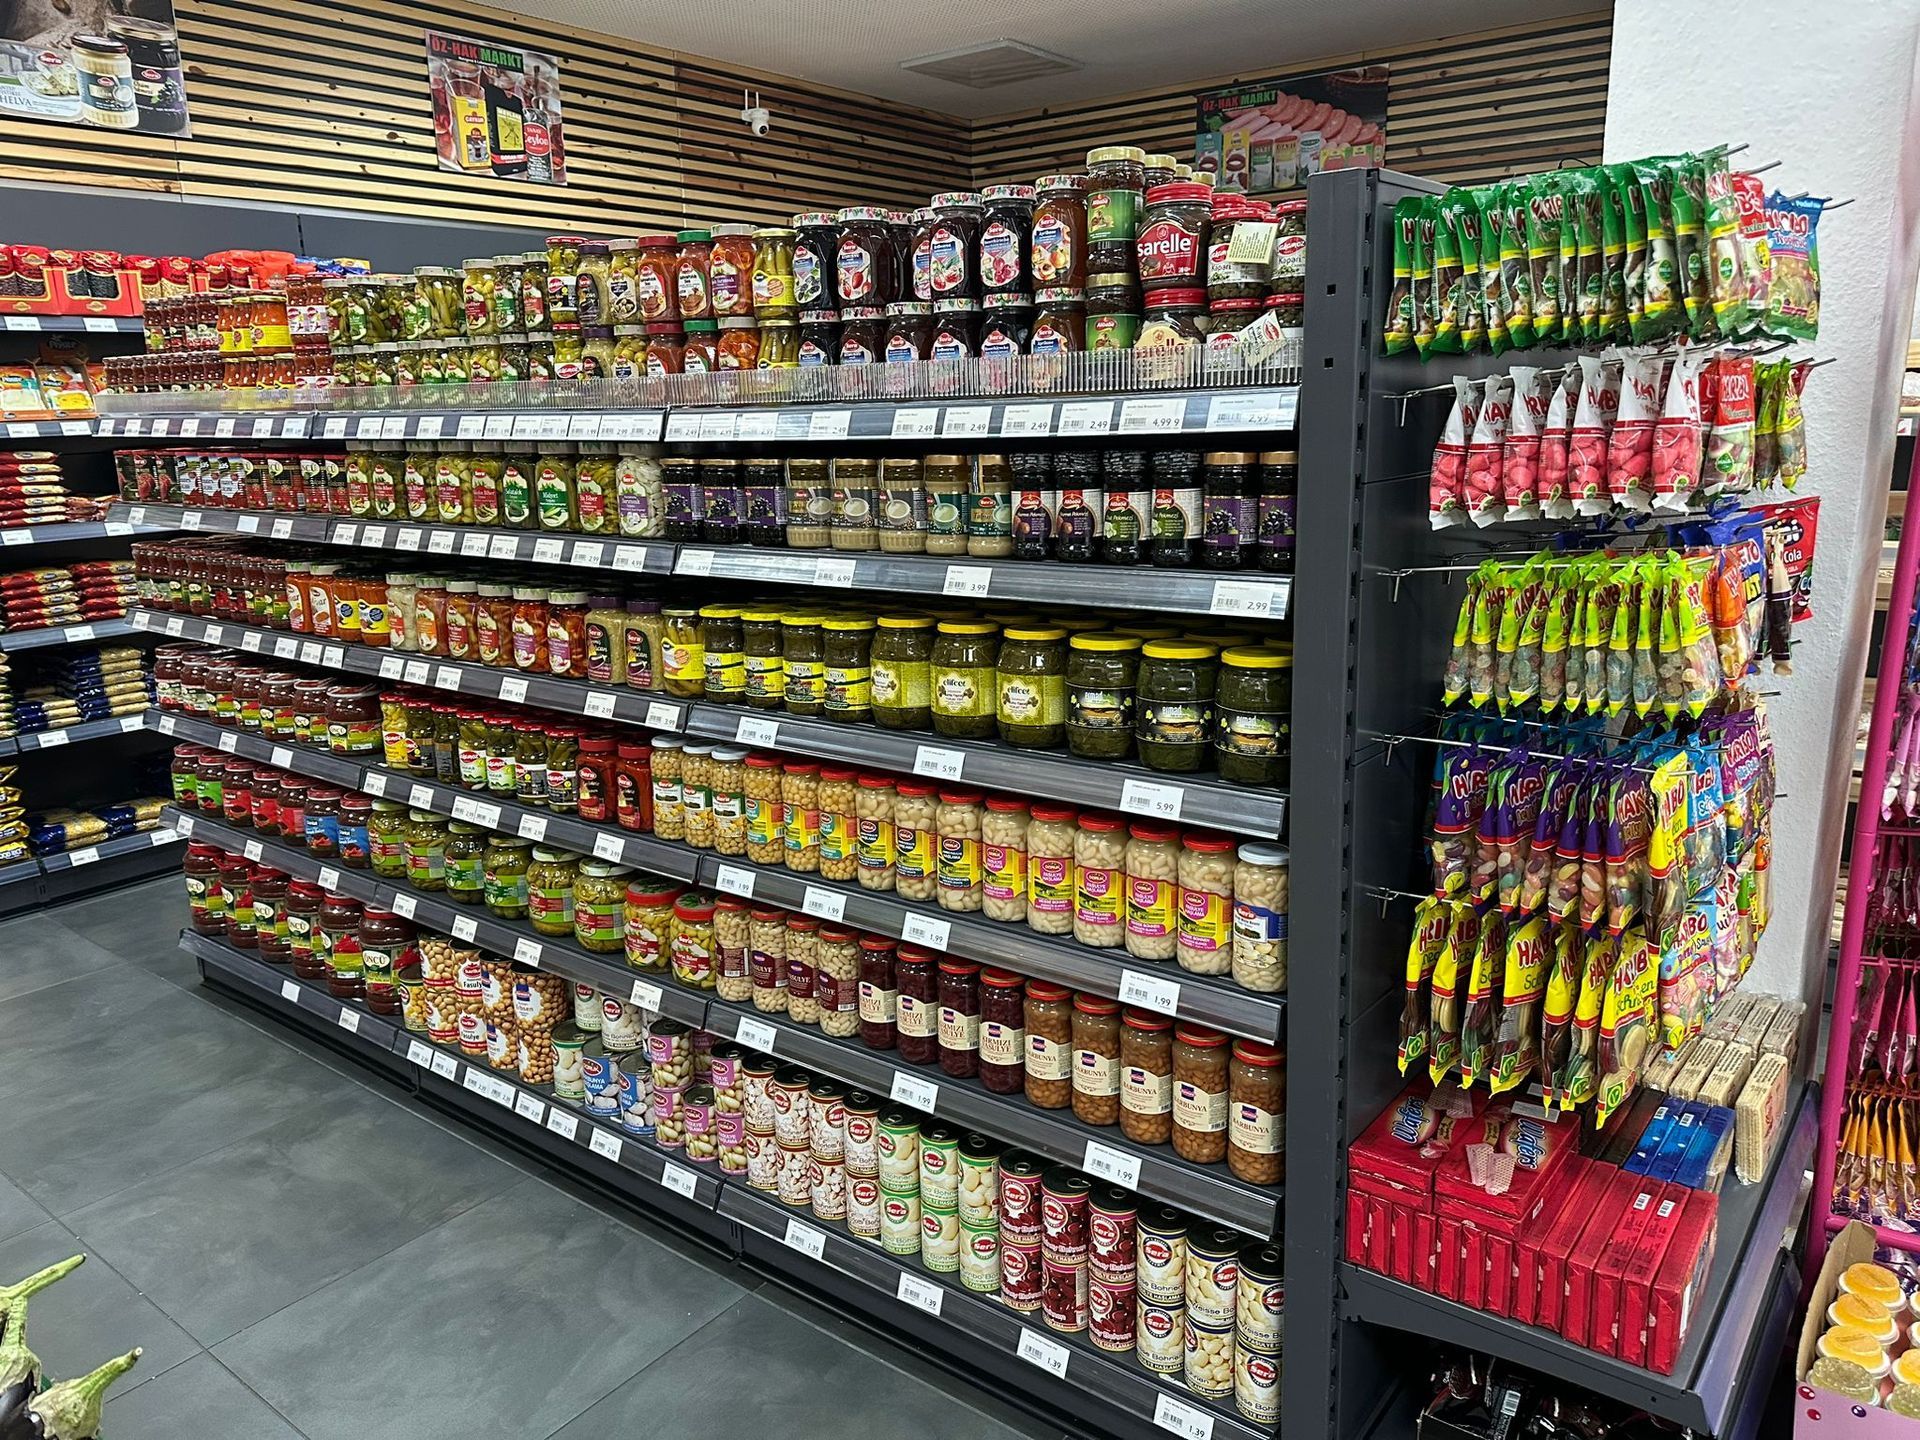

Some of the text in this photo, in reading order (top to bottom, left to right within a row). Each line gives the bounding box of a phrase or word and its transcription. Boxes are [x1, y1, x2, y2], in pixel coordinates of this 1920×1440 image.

[480, 48, 523, 68] MARKT
[1240, 89, 1277, 106] MARKT
[1137, 233, 1191, 257] sarelle
[1784, 549, 1802, 563] Cola
[463, 981, 482, 989] Fasuly
[1391, 1096, 1429, 1144] Wafers
[849, 1127, 870, 1135] Sera
[1517, 1118, 1546, 1170] Wafers
[924, 1157, 945, 1166] Sera
[854, 1189, 876, 1198] Sera
[1004, 1190, 1026, 1200] Sera
[886, 1206, 907, 1215] Sera
[1045, 1209, 1064, 1220] Sera
[1093, 1225, 1116, 1238] Sera
[973, 1243, 996, 1251] Sera
[1144, 1247, 1170, 1259] Sera
[1145, 1317, 1171, 1328] Sera
[1249, 1365, 1277, 1378] Sera
